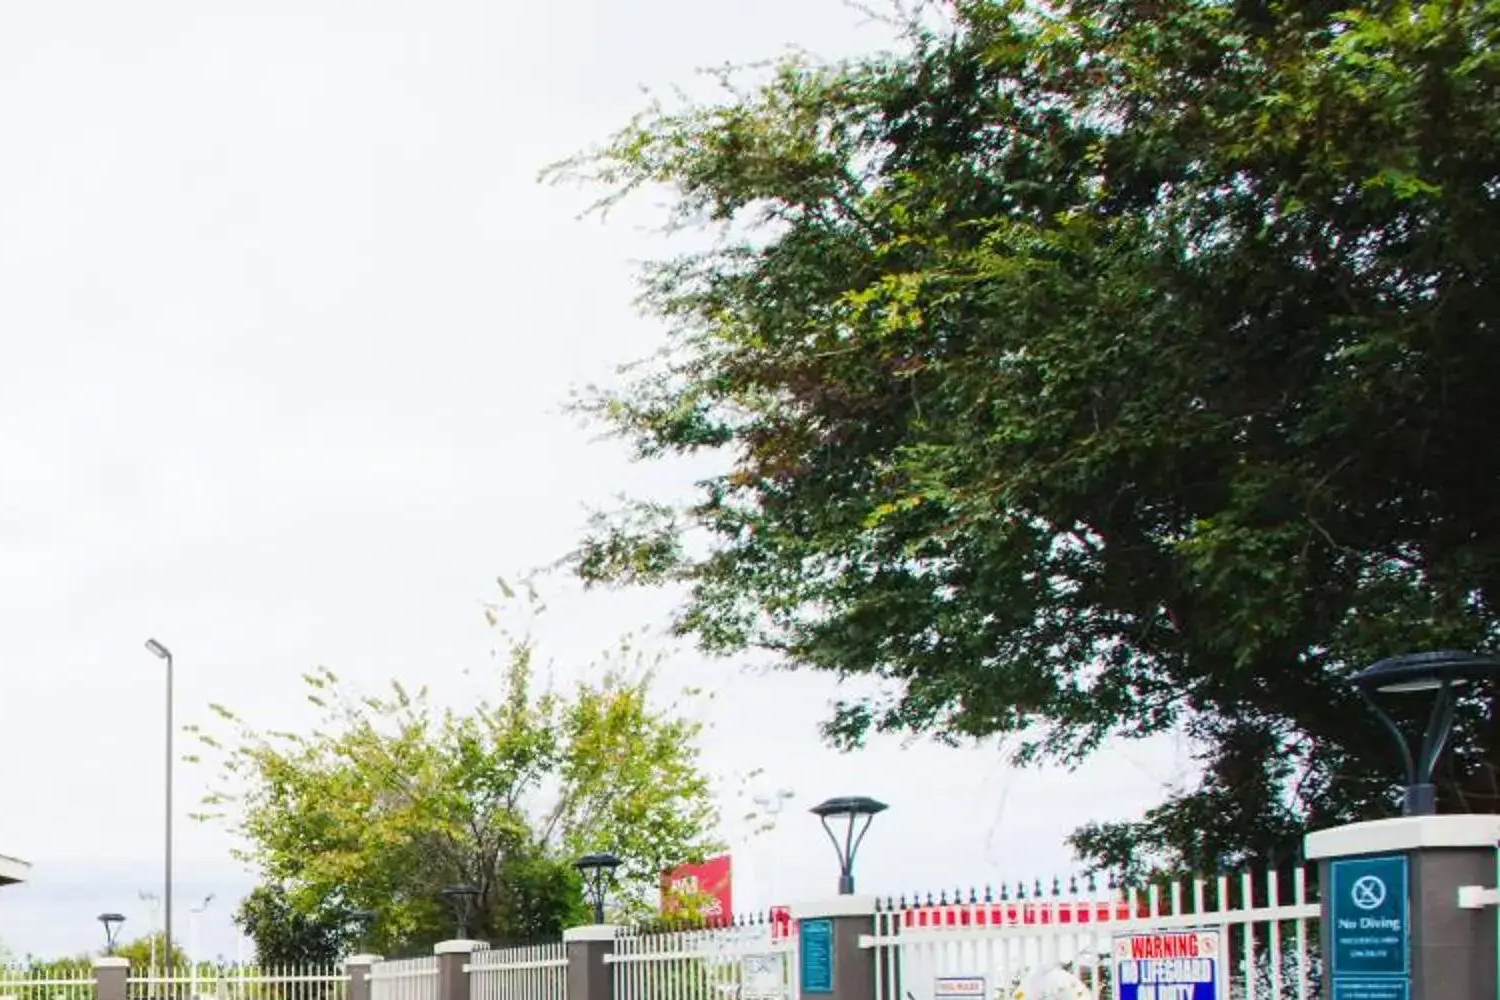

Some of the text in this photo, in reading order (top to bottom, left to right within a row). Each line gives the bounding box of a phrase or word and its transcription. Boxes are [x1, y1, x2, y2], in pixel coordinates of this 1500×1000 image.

[1338, 917, 1401, 932] No Diving
[1131, 932, 1199, 958] WARNING
